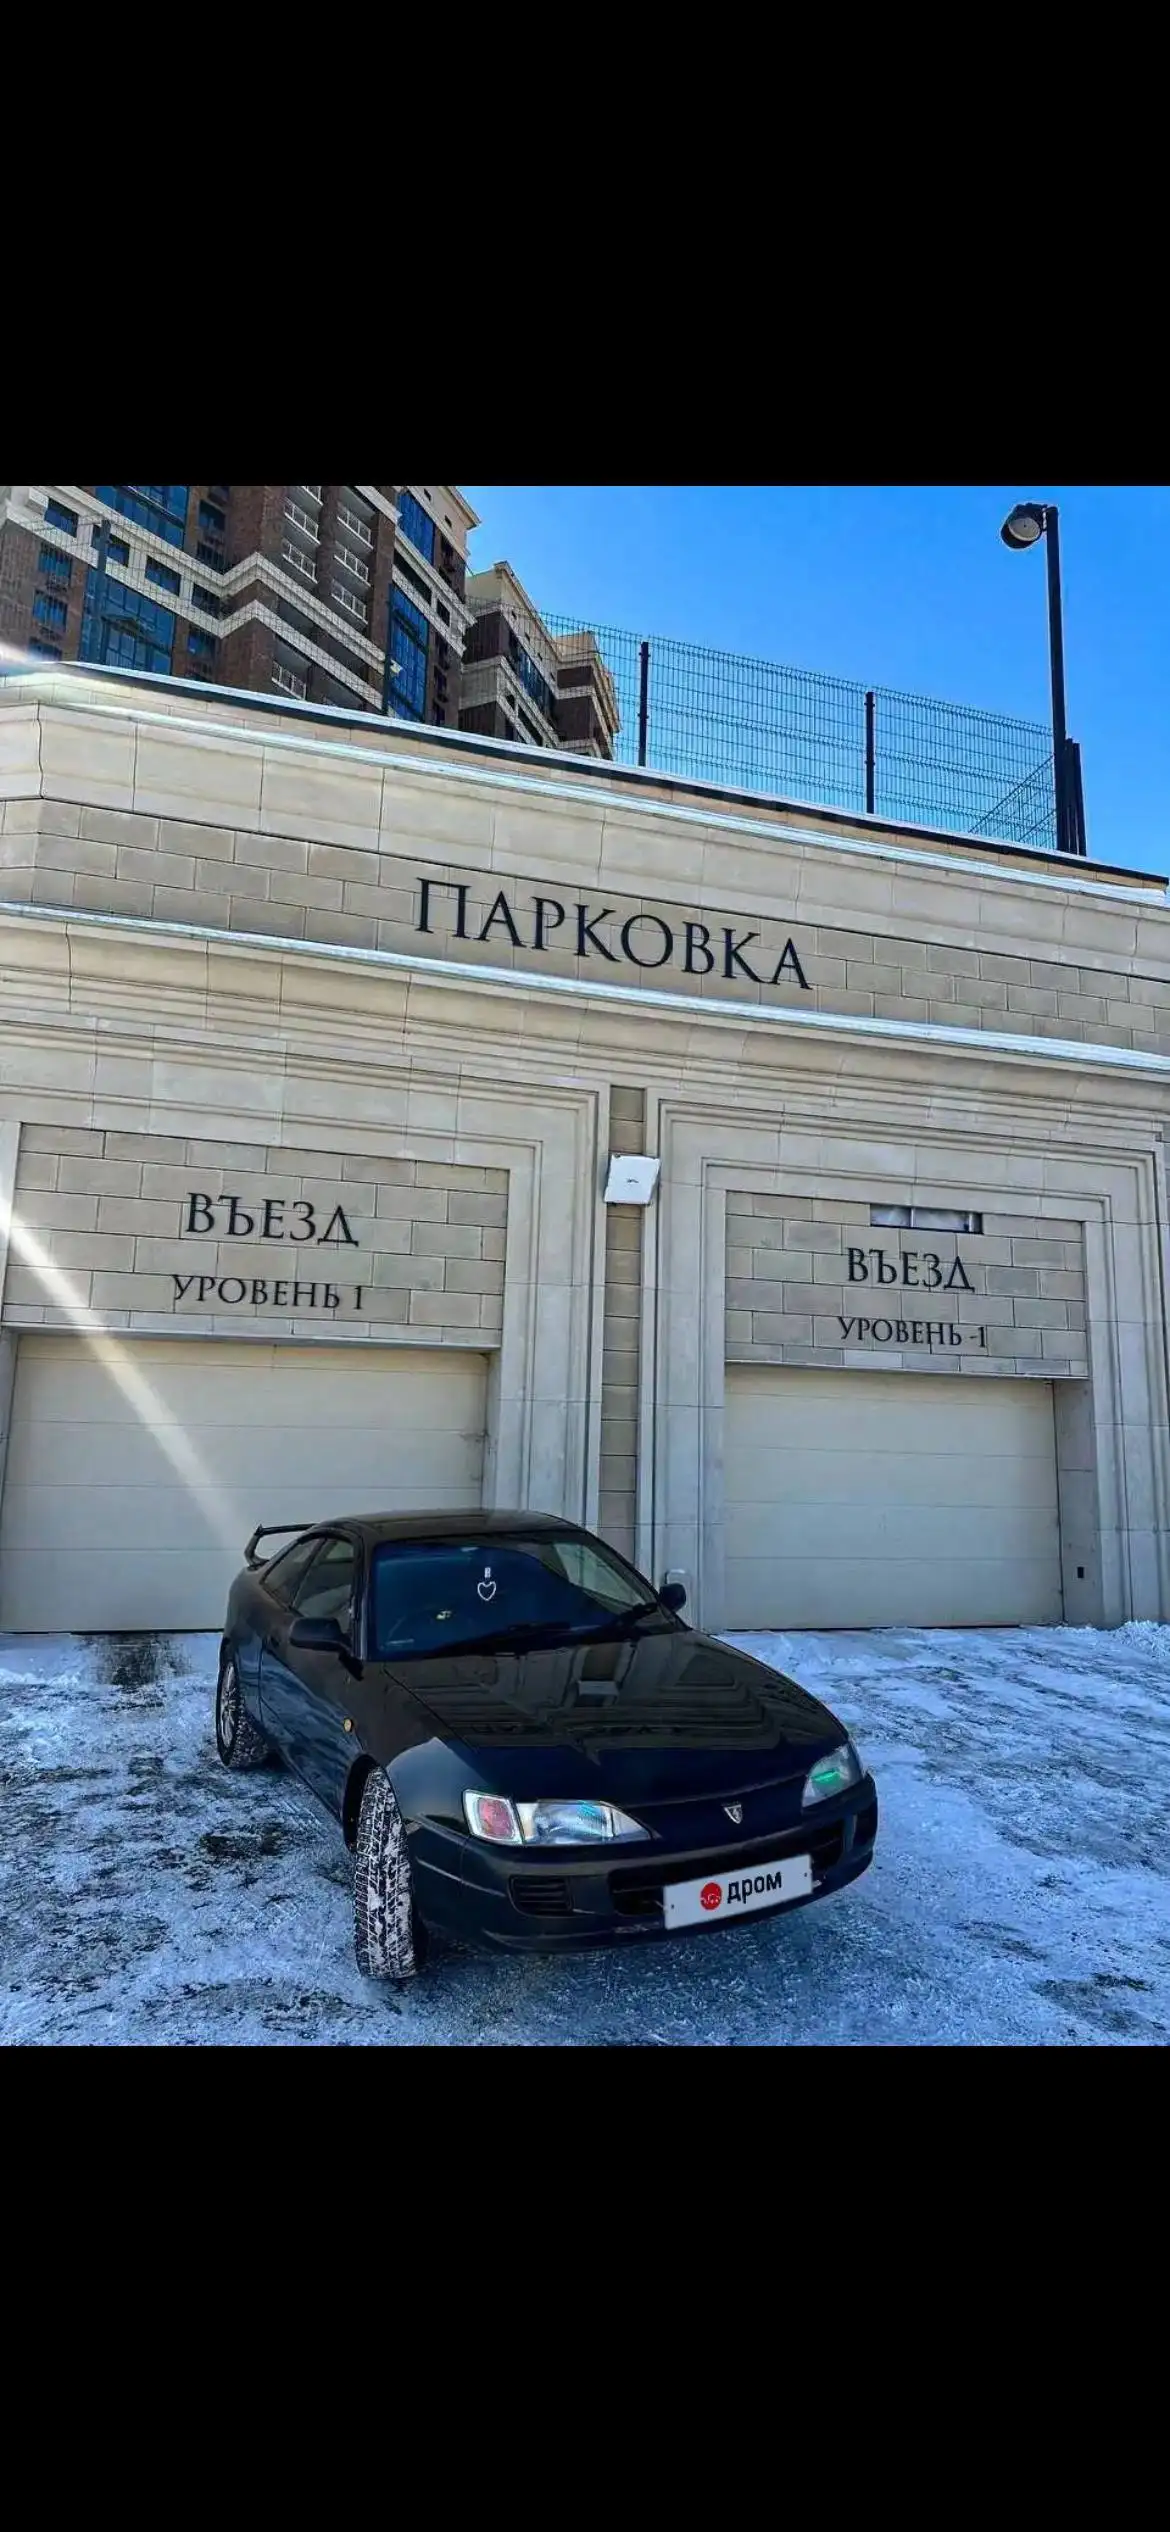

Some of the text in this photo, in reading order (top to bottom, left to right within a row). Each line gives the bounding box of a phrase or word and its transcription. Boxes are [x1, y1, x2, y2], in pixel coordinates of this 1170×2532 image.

[415, 877, 813, 990] ПАРКОВКА
[186, 1192, 359, 1247] ВЪЕЗД
[172, 1274, 362, 1310] УРОВЕНЬ 1
[846, 1247, 975, 1293] ВЪЕЗД
[837, 1316, 986, 1348] УРОВЕНЬ -1
